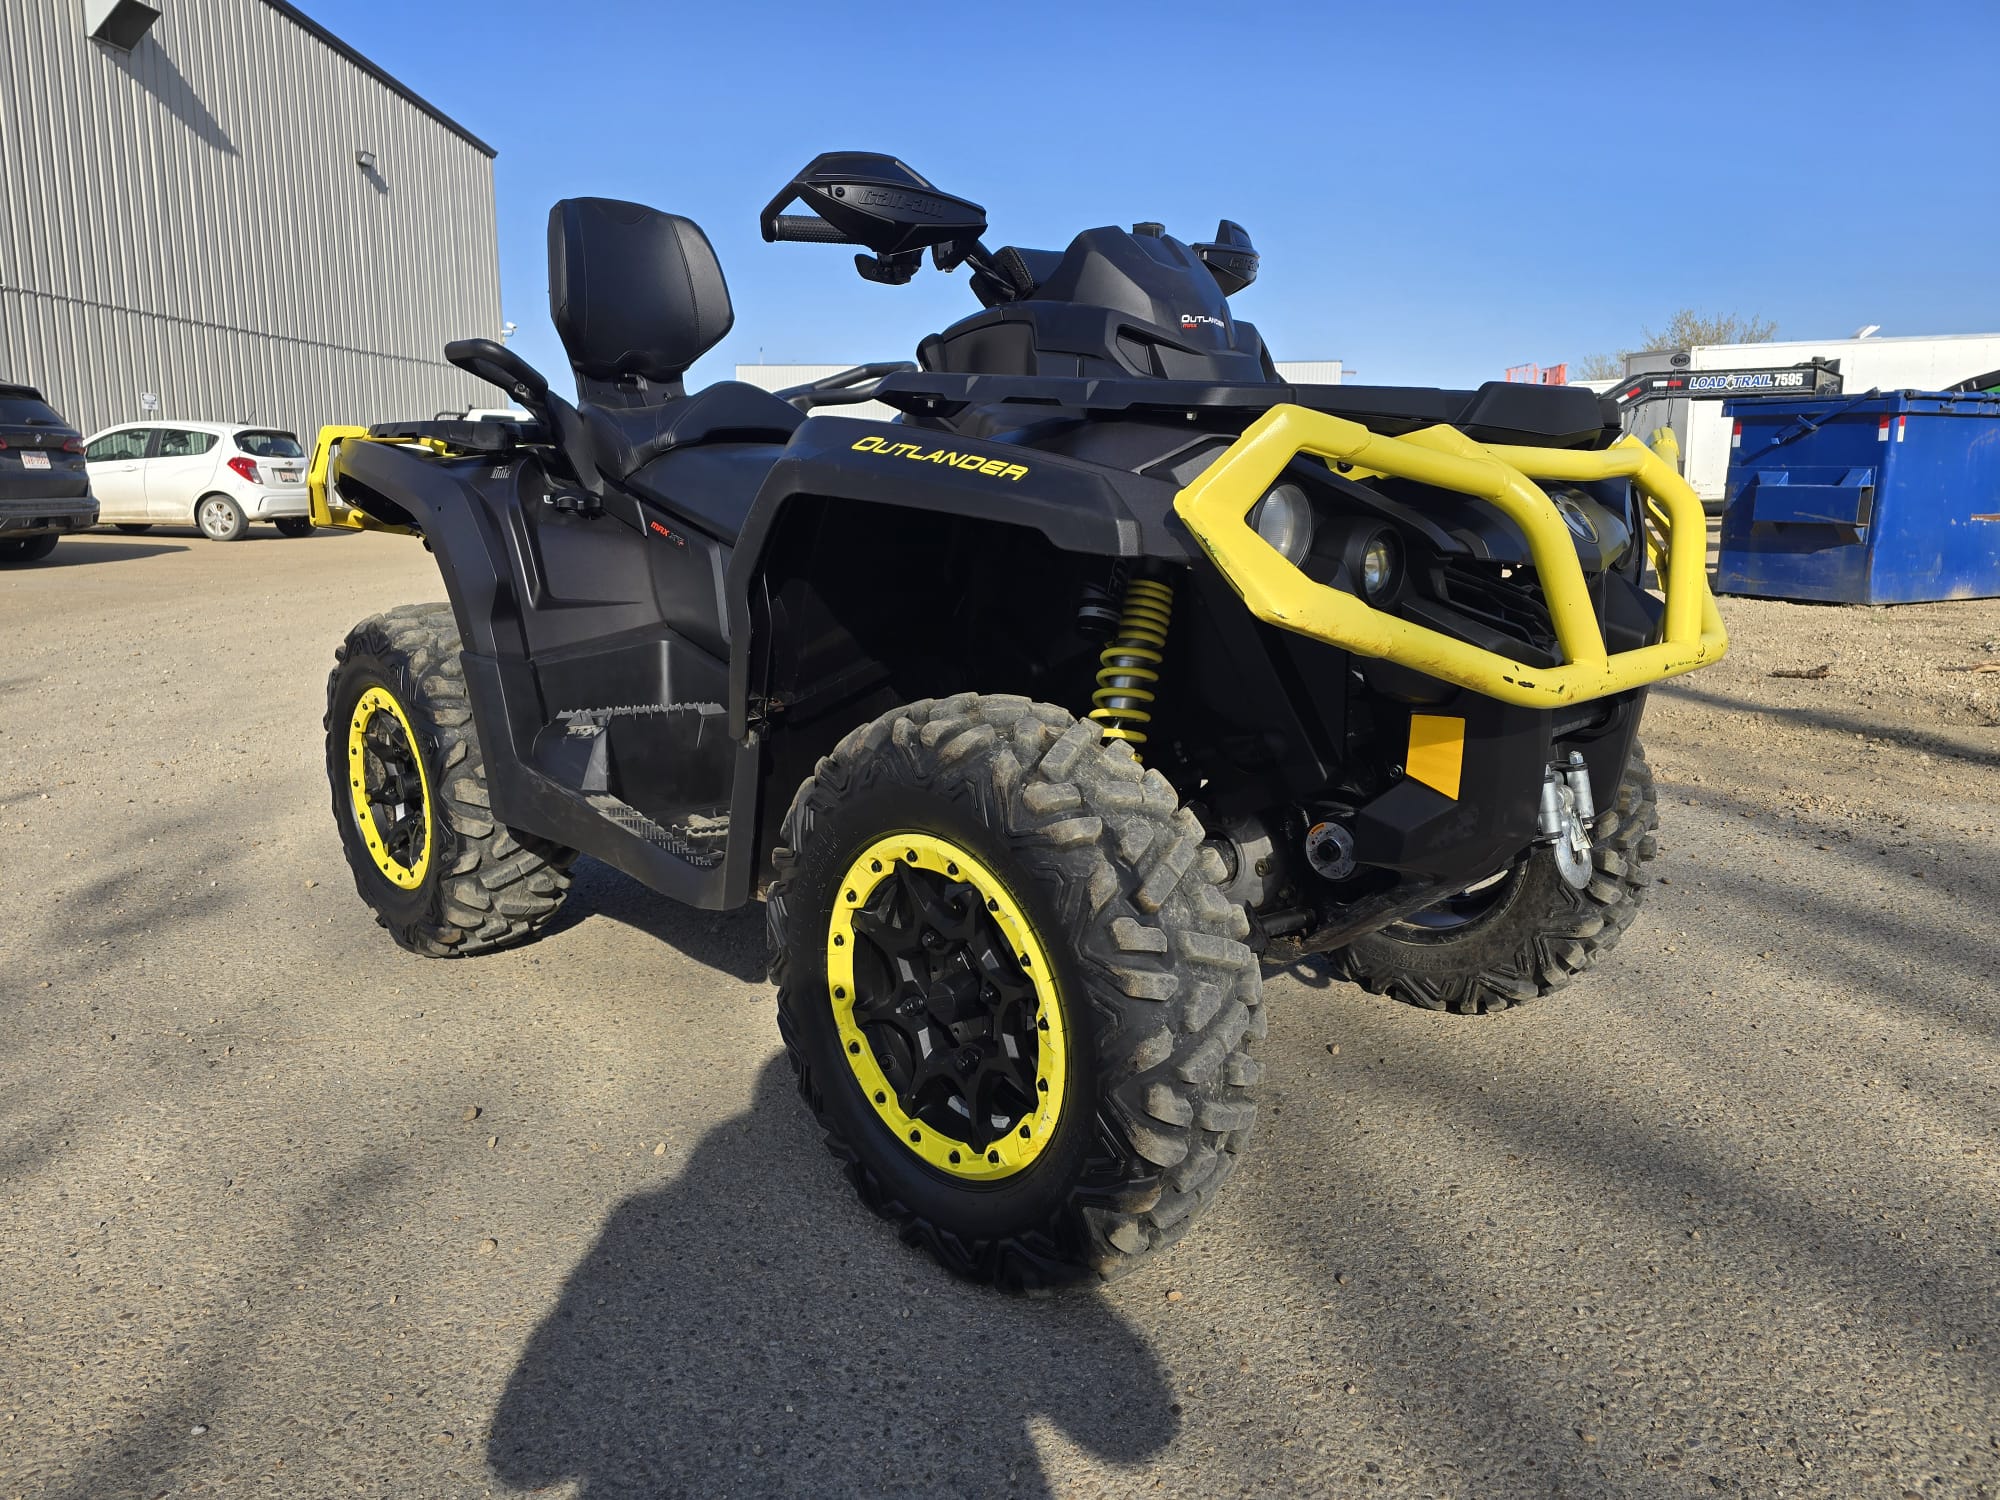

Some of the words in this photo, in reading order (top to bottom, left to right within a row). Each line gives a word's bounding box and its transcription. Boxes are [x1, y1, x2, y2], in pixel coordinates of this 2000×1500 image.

[1689, 377, 1727, 390] LOAD
[1732, 374, 1773, 388] TRAIL
[1774, 373, 1804, 387] 7595
[851, 436, 1029, 481] OUTLANDER
